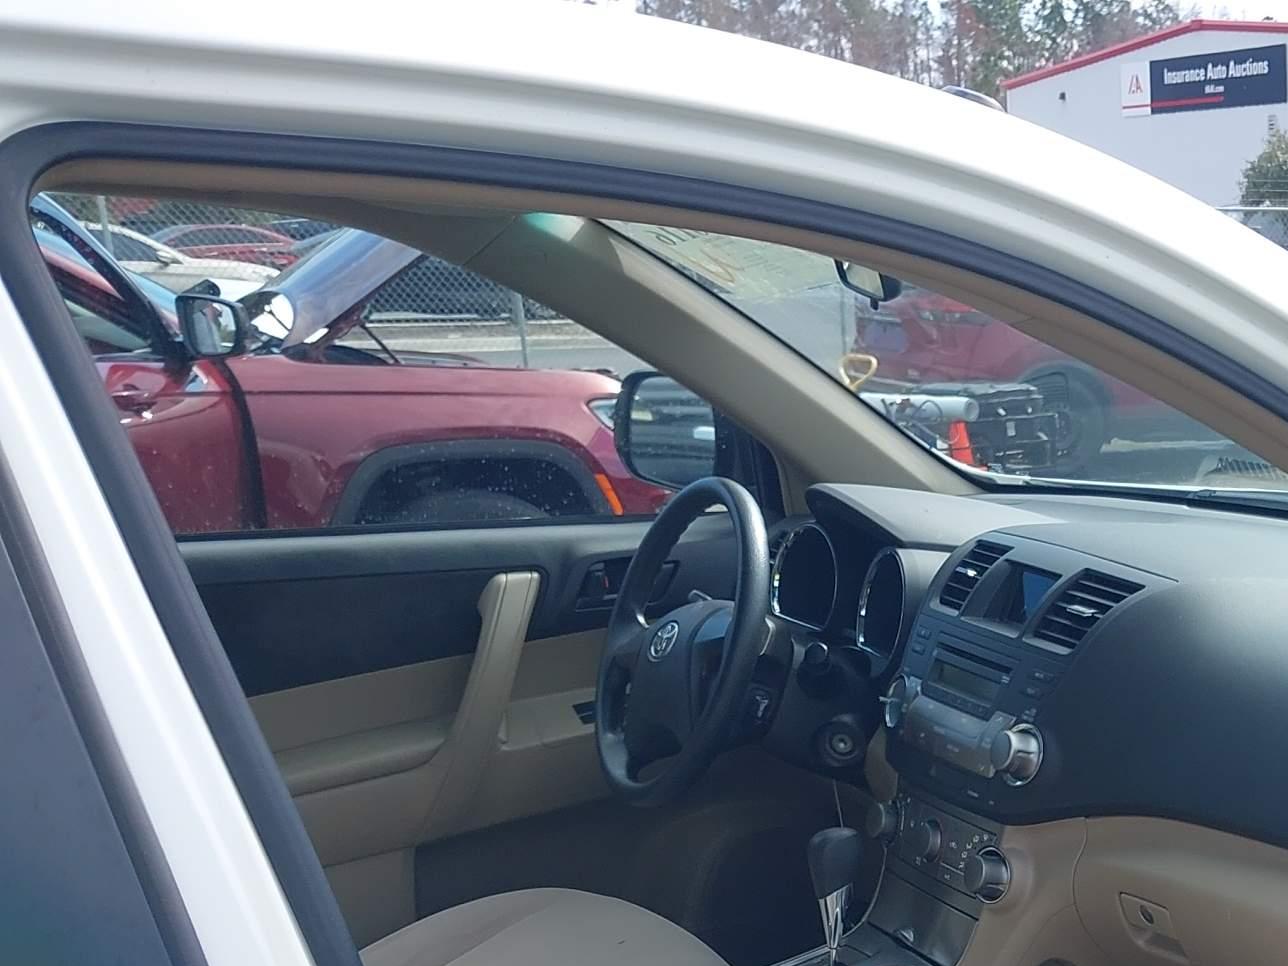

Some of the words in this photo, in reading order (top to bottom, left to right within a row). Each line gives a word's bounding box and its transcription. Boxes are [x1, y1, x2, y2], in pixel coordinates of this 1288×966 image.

[1163, 67, 1206, 85] Insurance
[1206, 62, 1227, 81] Auto
[1228, 58, 1269, 79] Auctions
